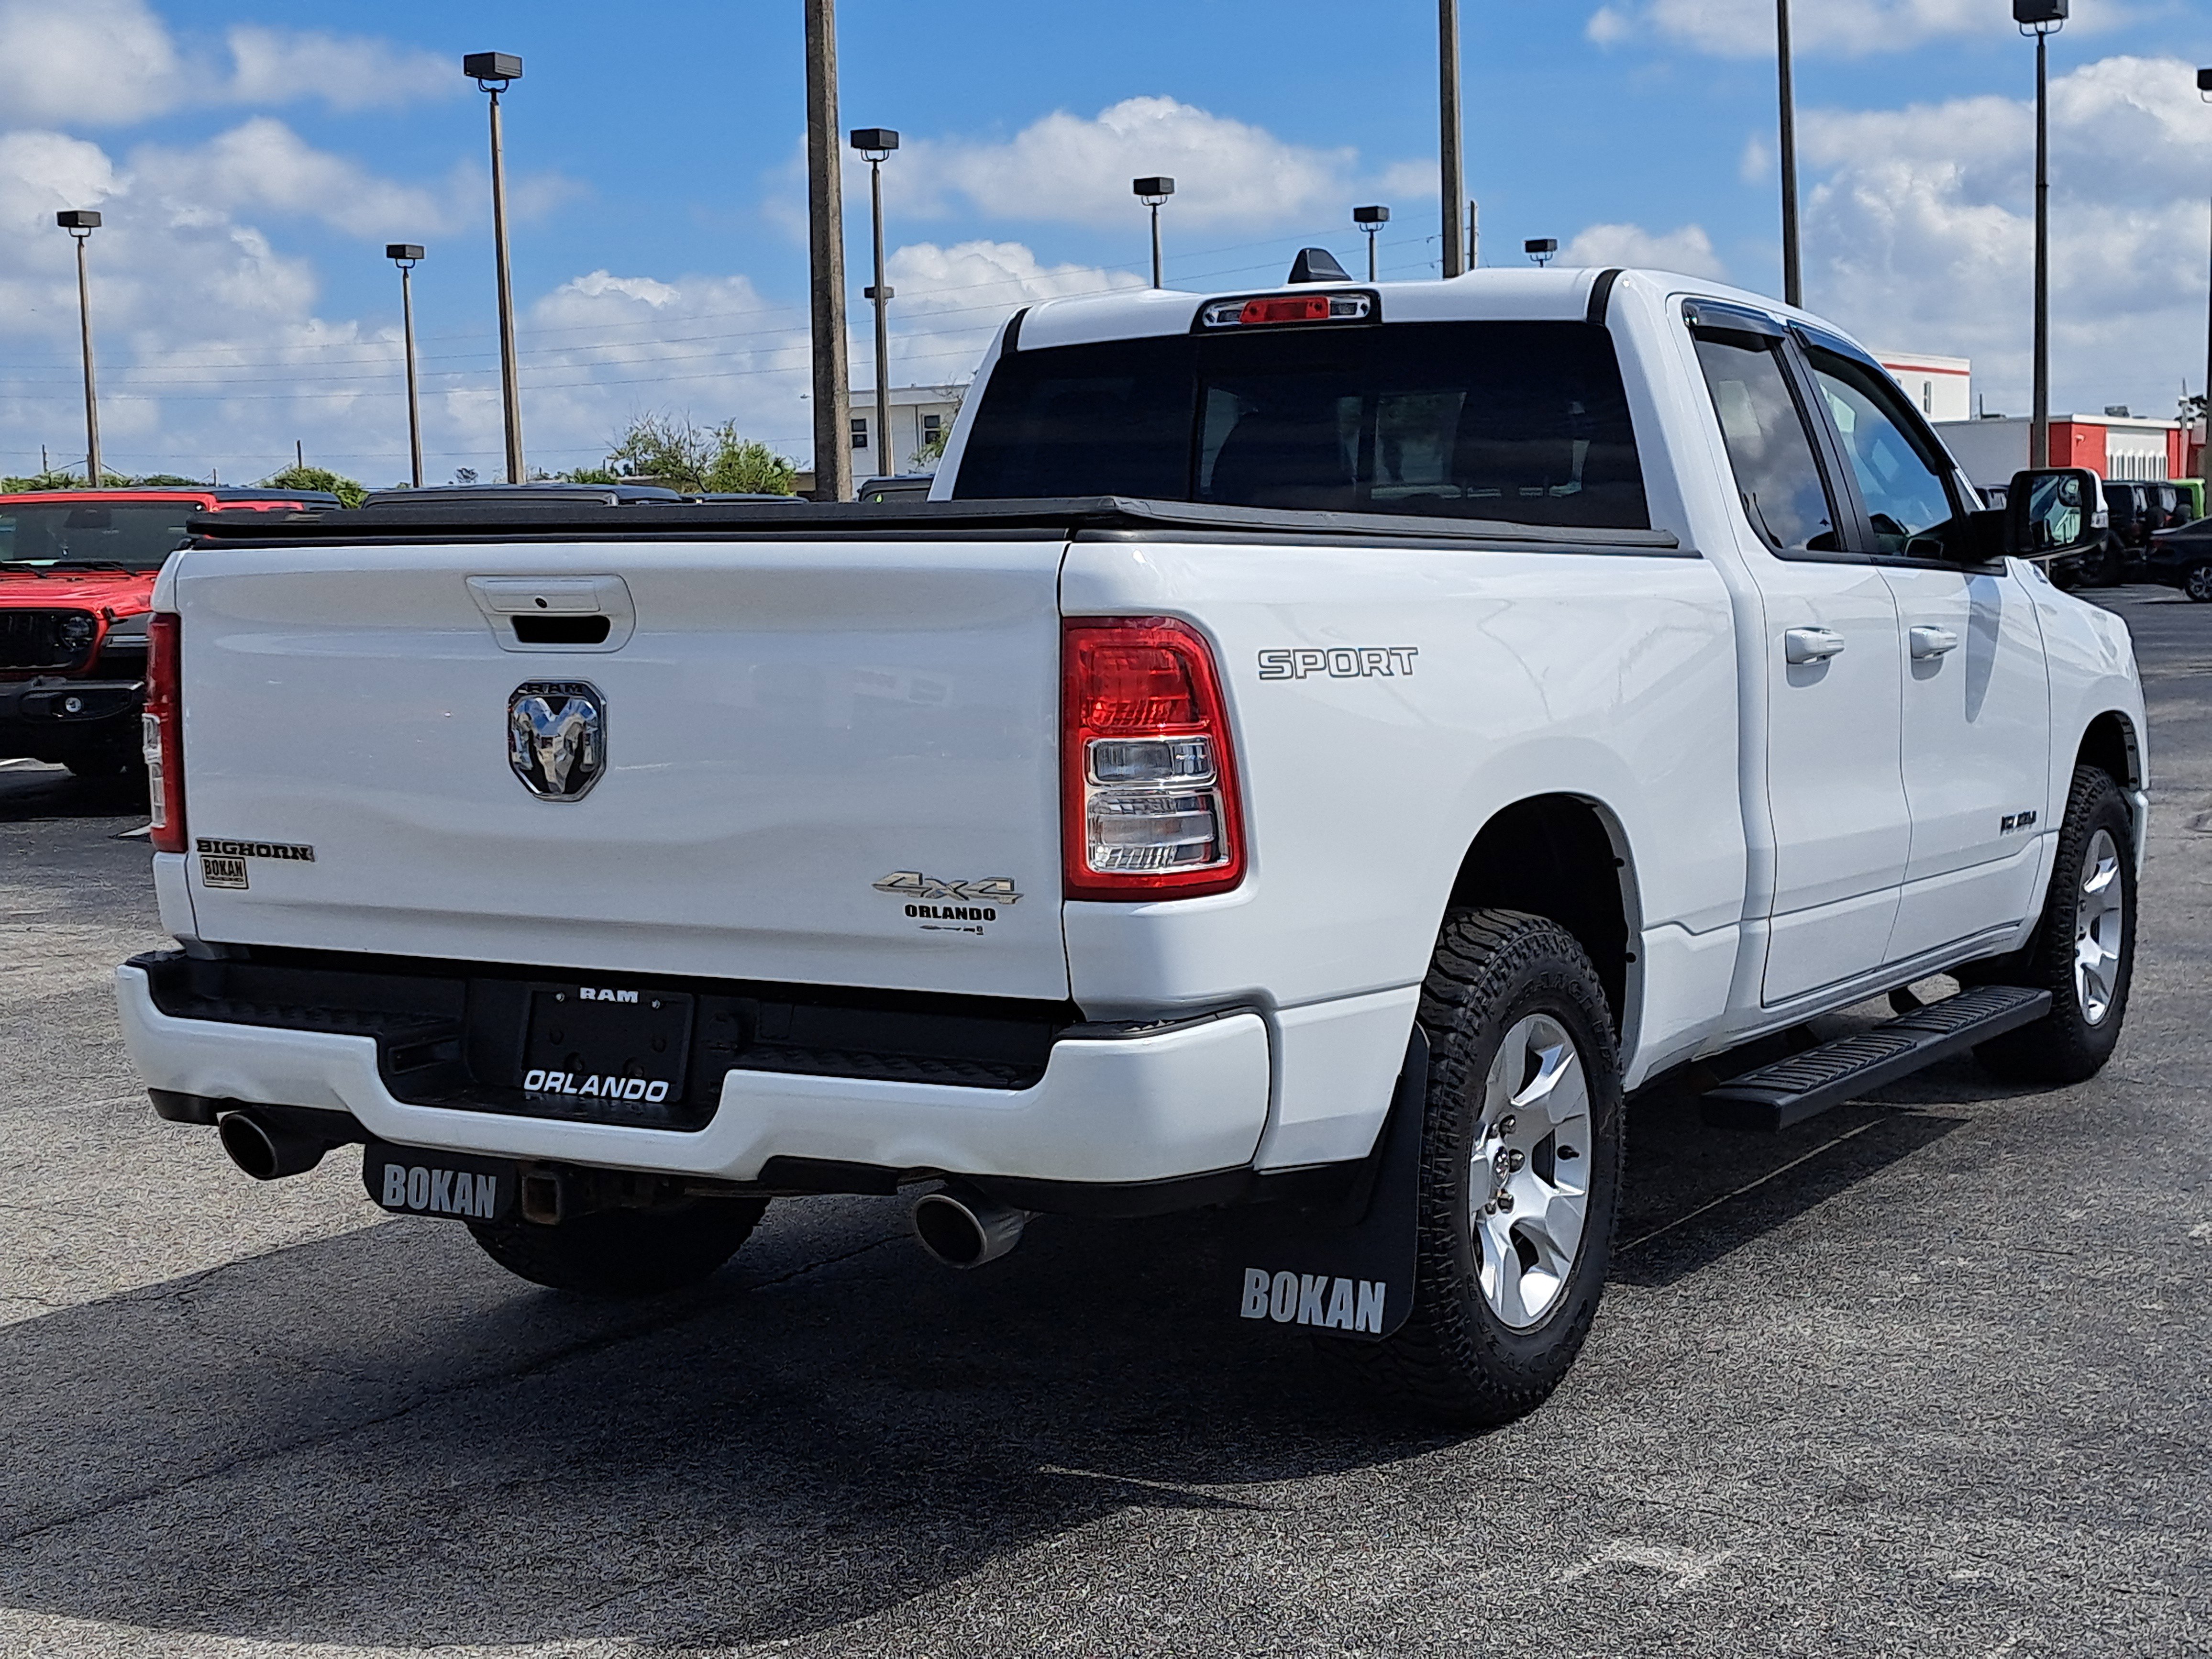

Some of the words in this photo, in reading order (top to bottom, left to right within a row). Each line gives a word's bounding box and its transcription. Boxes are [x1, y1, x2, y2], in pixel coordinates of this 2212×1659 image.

[1258, 647, 1418, 680] SPORT
[196, 839, 314, 862] BIGHORN
[204, 859, 243, 877] BOKAN
[905, 904, 996, 921] ORLANDO
[580, 987, 638, 1003] RAM
[524, 1069, 669, 1103] ORLANDO
[382, 1163, 497, 1219] BOKAN
[1240, 1267, 1386, 1334] BOKAN
